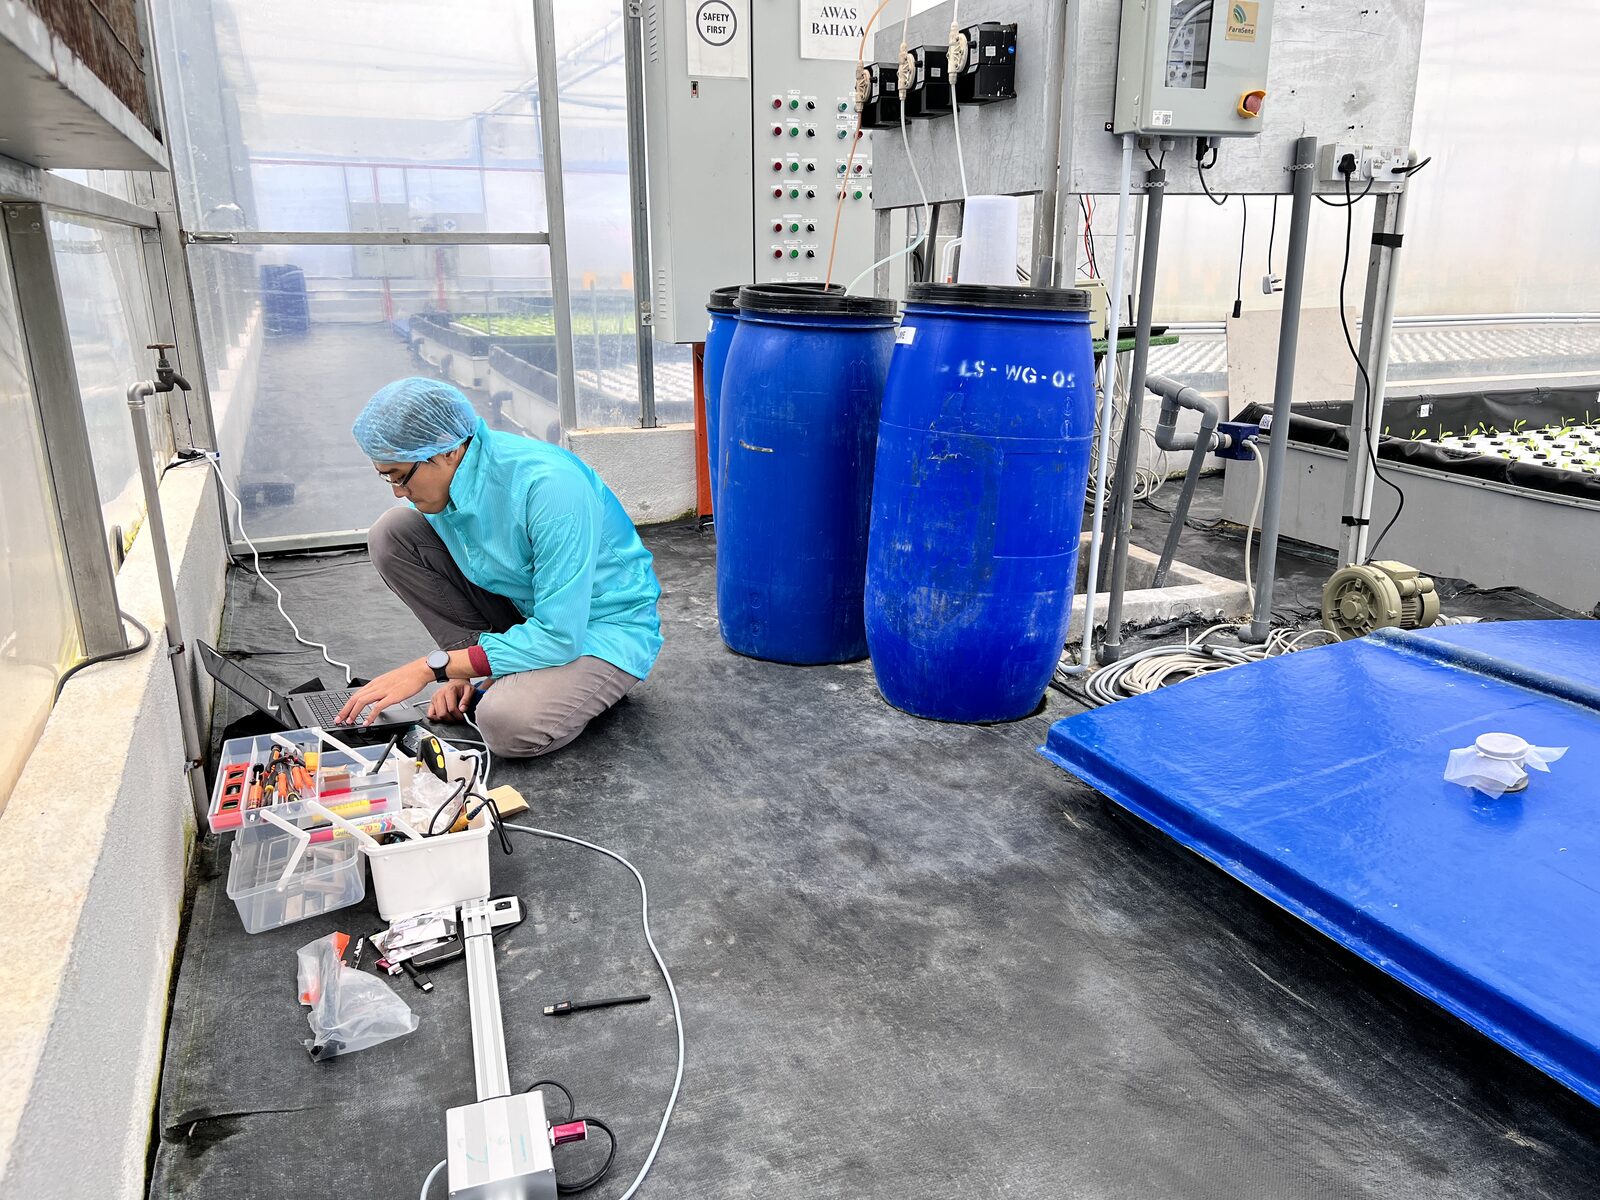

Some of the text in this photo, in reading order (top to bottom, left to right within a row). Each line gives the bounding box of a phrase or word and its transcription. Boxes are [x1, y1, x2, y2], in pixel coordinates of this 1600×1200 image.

[703, 12, 730, 22] SAFETY
[820, 6, 857, 20] AWAS
[706, 25, 727, 35] FIRST
[812, 22, 865, 38] BAHAYA
